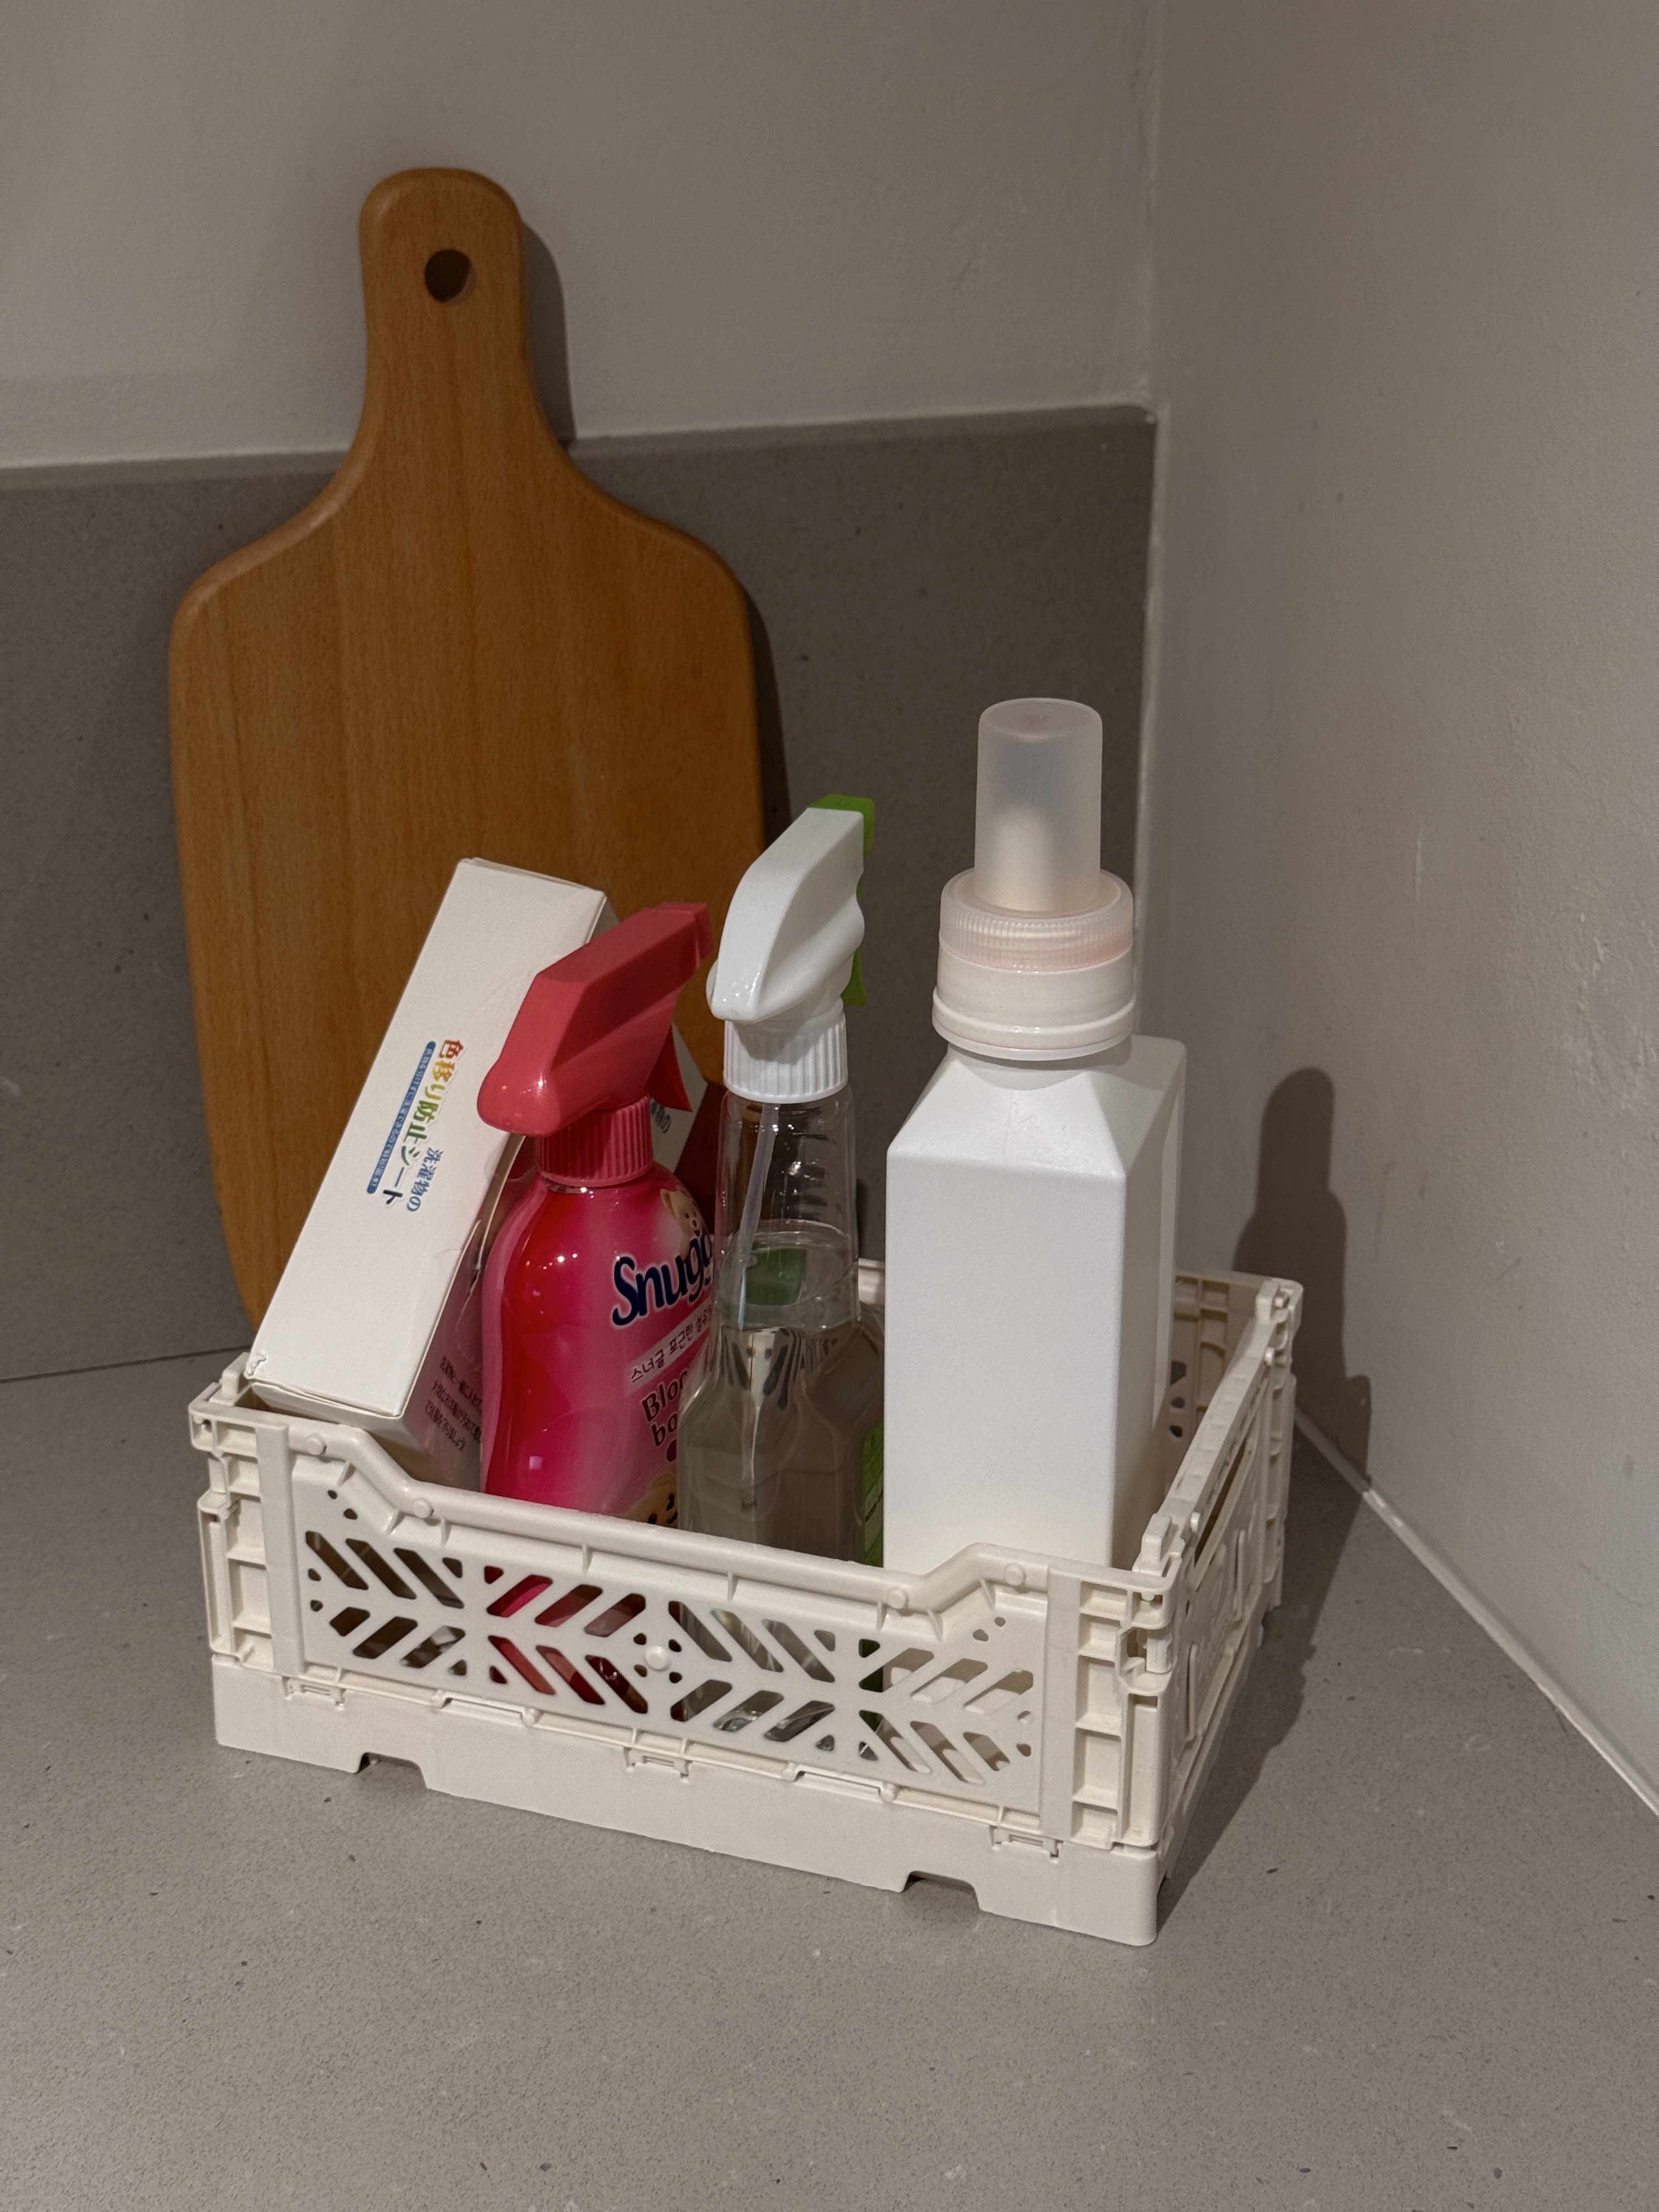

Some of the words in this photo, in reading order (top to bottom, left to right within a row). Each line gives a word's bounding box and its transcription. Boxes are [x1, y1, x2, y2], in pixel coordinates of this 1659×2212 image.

[383, 1040, 464, 1204] 色移り防止シート
[407, 1147, 443, 1211] 洗濯物の
[630, 1348, 665, 1383] 스너글
